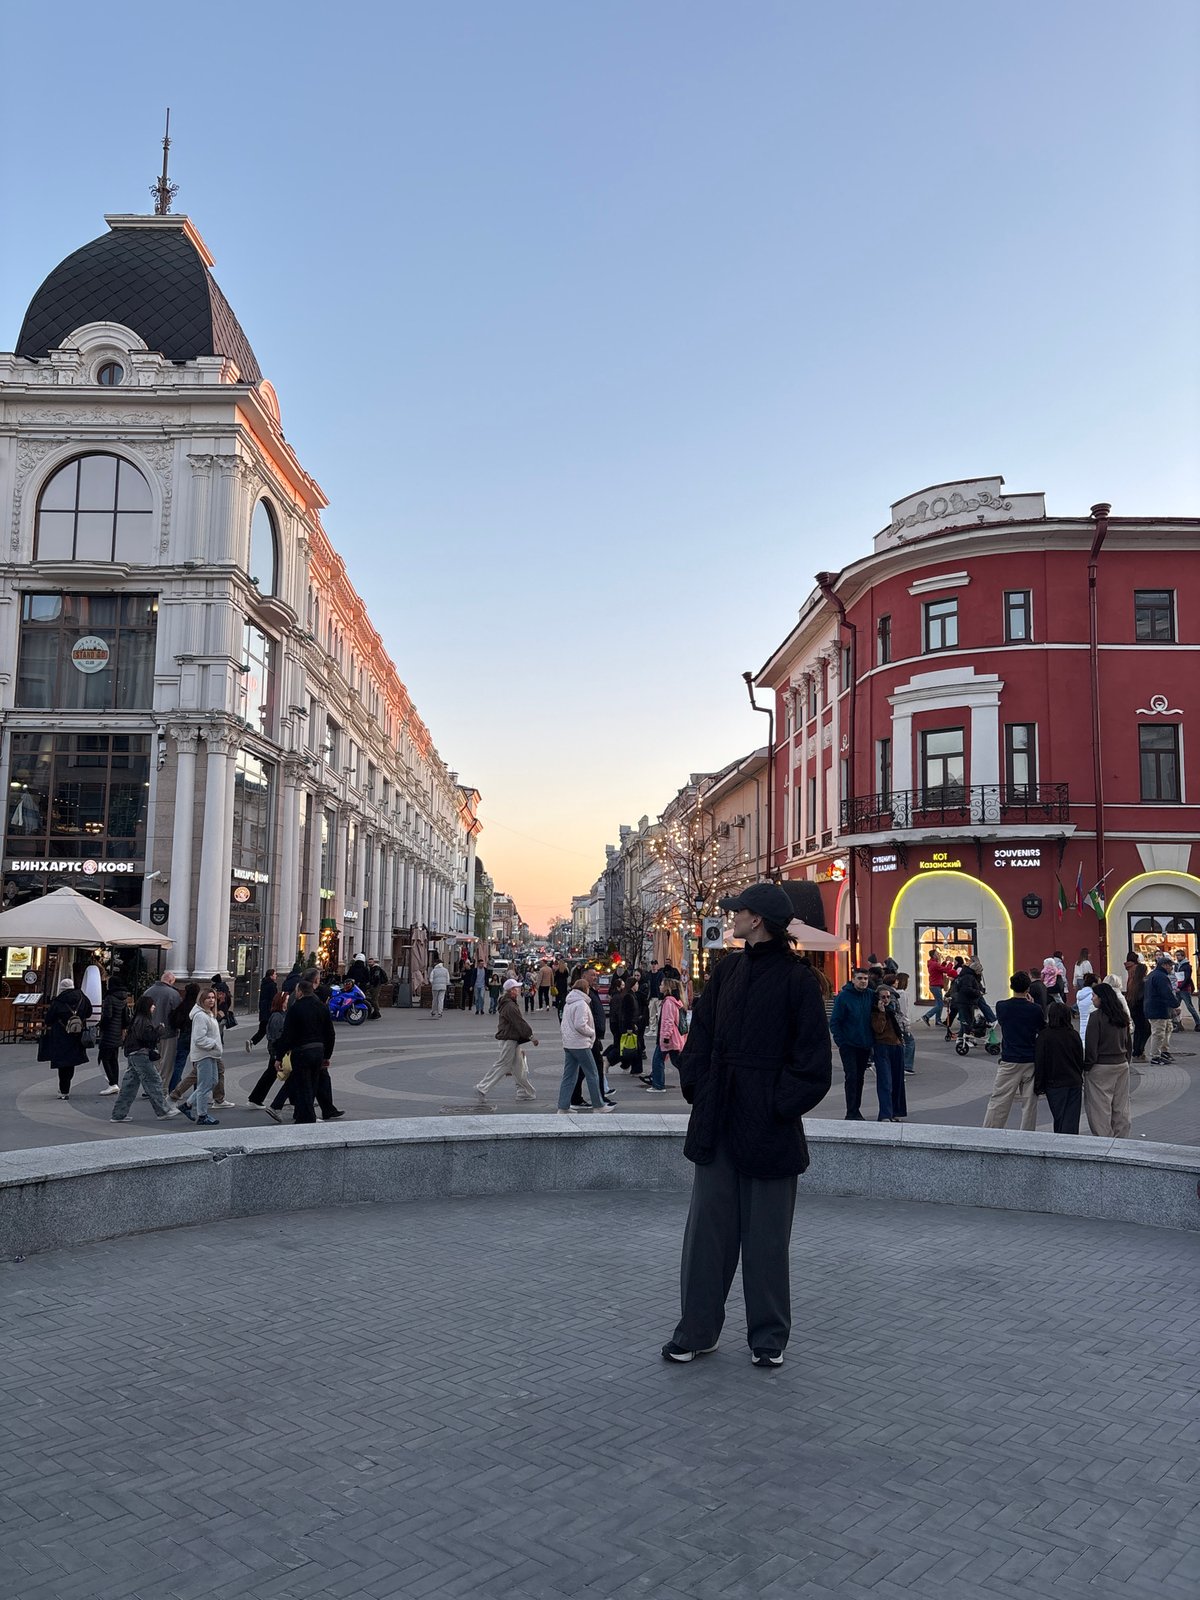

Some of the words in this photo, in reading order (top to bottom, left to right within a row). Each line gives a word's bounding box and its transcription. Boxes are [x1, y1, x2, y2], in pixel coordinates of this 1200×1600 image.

[75, 651, 95, 659] STAND
[933, 853, 948, 861] КОТ
[994, 849, 1041, 858] SOUVENIRS
[11, 861, 82, 872] БИНХАРТС
[98, 862, 134, 872] КОФЕ
[920, 860, 962, 869] Казанский
[994, 859, 1006, 867] OF
[1010, 859, 1041, 867] KAZAN
